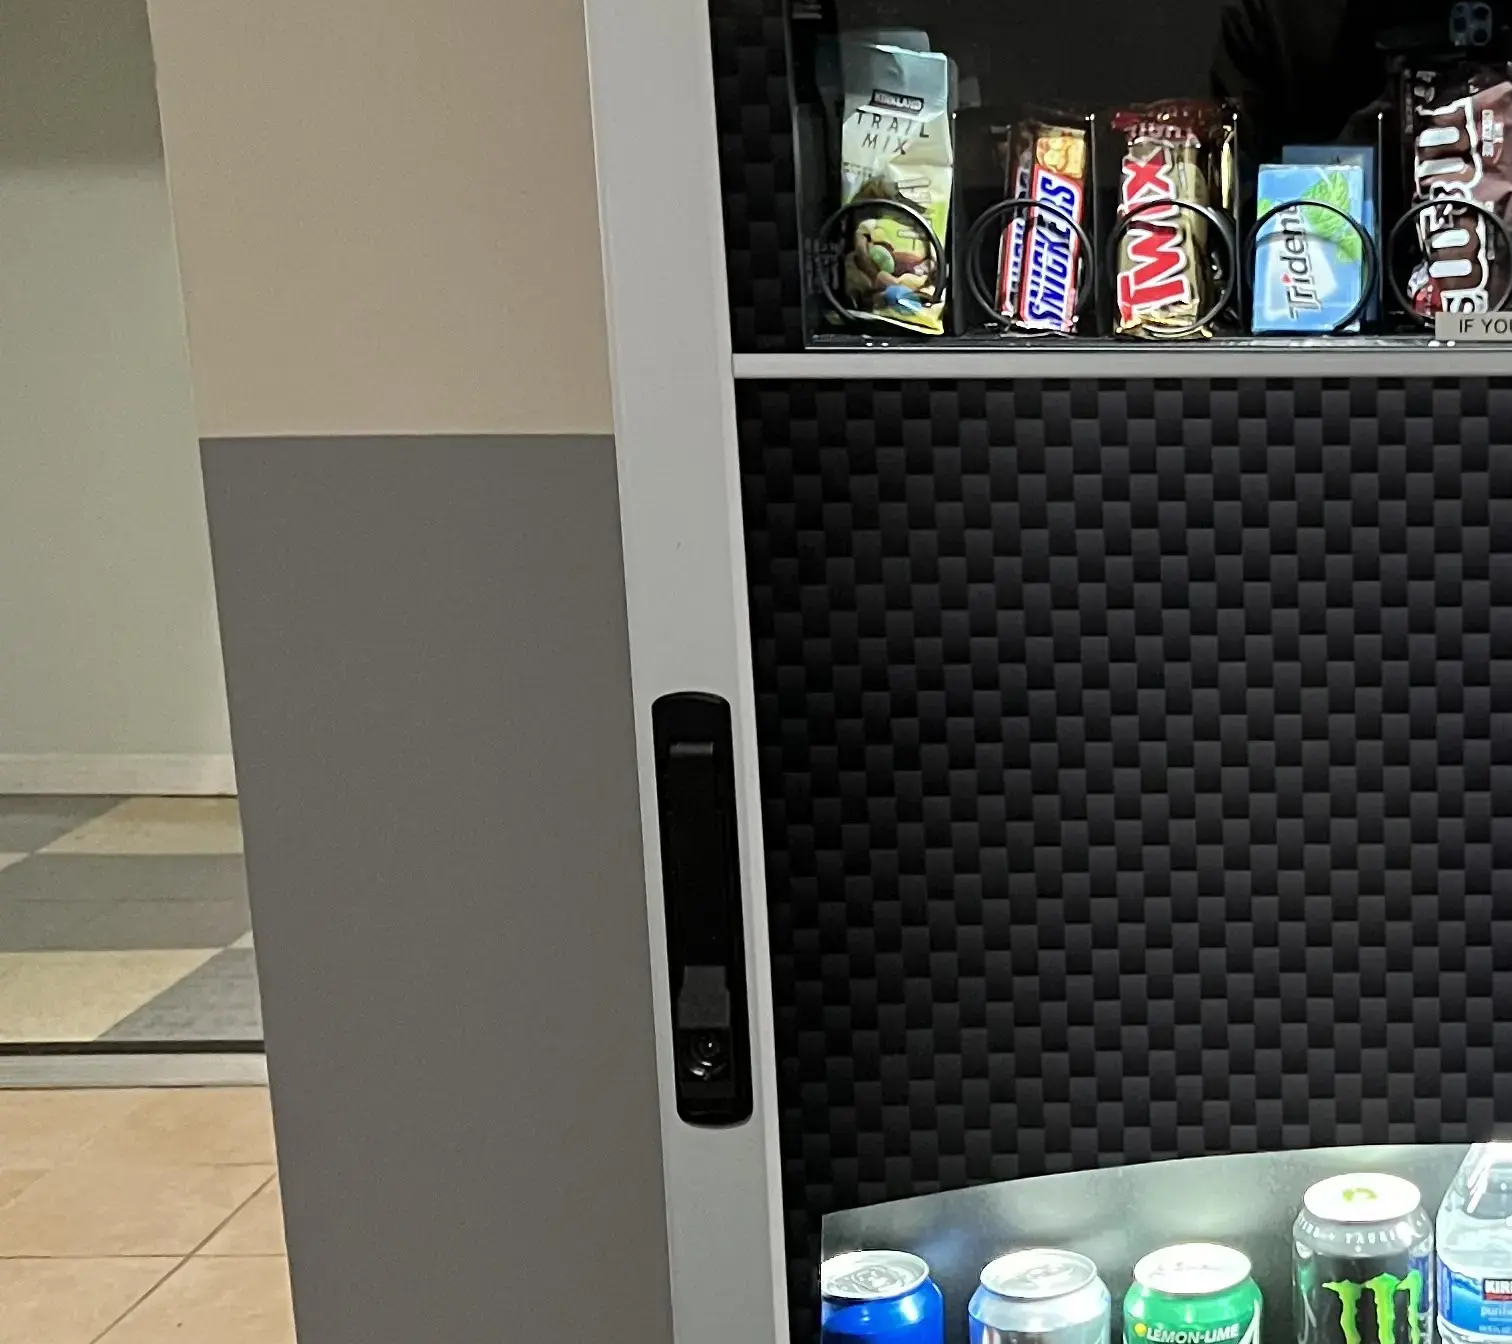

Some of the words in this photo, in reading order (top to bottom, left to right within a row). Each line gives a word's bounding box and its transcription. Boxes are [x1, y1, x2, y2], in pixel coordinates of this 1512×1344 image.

[856, 109, 930, 138] TRAIL
[862, 133, 907, 156] MIX
[1028, 176, 1075, 325] SNICKERS
[1280, 205, 1322, 320] Trident
[1459, 318, 1474, 333] IF
[1146, 1323, 1239, 1344] LEMON-LIME
